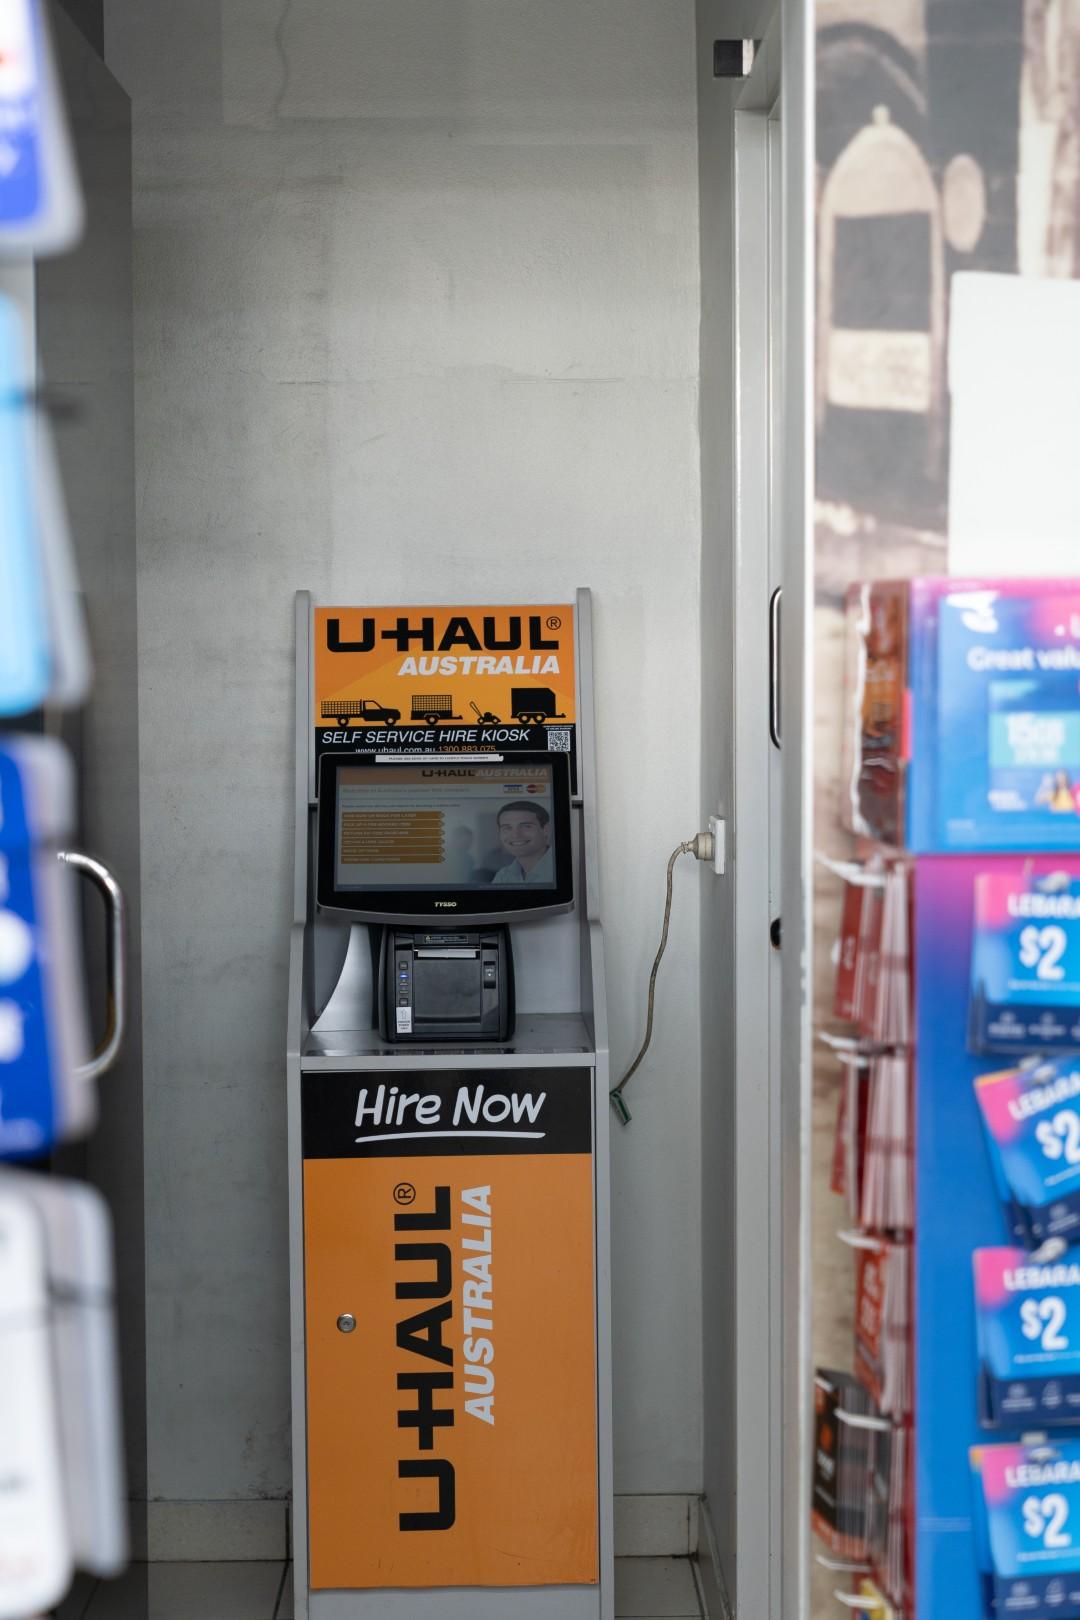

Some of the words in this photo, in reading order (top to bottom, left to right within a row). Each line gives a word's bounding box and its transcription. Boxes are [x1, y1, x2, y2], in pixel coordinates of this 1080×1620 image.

[397, 655, 560, 676] AUSTRALIA
[322, 731, 362, 744] SELF
[365, 730, 436, 743] SERVICE
[439, 730, 478, 742] HIRE
[481, 729, 531, 741] KIOSK
[422, 769, 475, 777] U-HAUL
[476, 768, 548, 777] AUSTRALIA
[1019, 925, 1067, 980] $2
[355, 1084, 442, 1127] Hire
[1035, 1109, 1080, 1165] $2
[461, 1185, 496, 1425] AUSTRALIA
[1020, 1295, 1069, 1351] $2
[1022, 1493, 1071, 1550] $2
